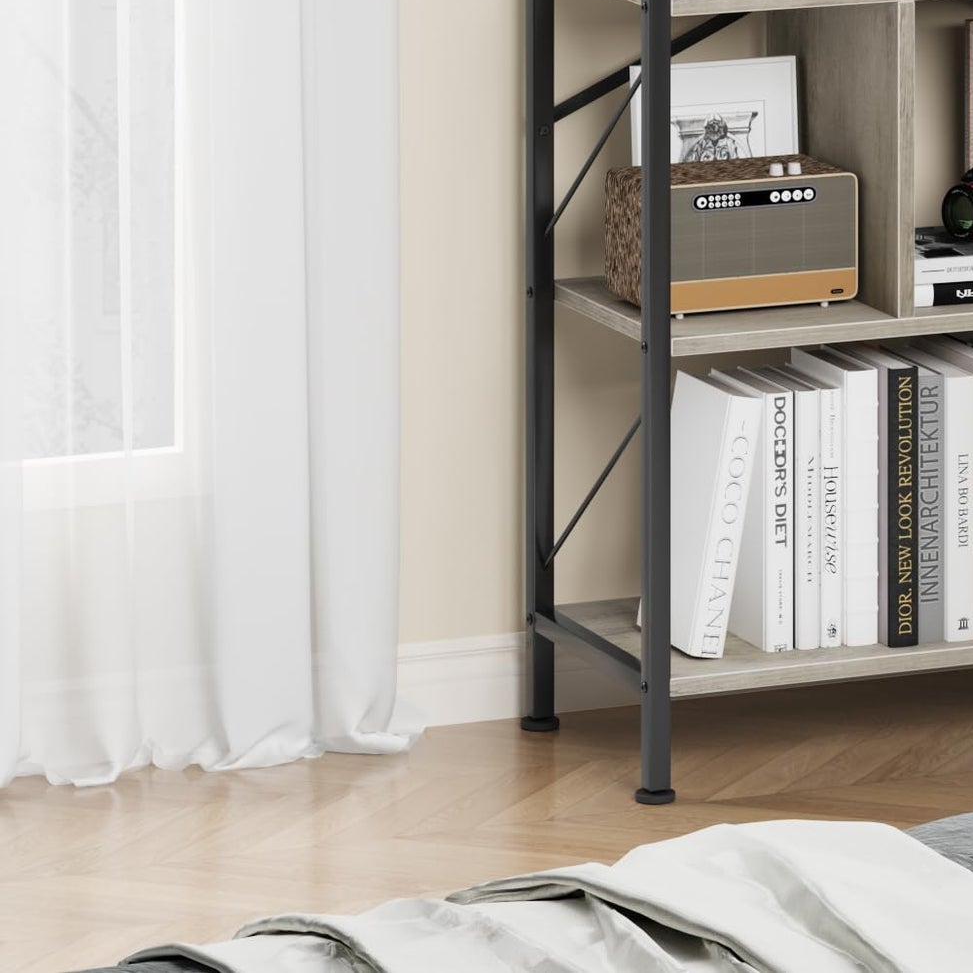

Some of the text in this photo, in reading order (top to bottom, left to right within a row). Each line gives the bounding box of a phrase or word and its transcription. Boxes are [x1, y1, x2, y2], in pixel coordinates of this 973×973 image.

[774, 504, 788, 547] DIET
[823, 466, 839, 575] Housewise
[898, 377, 912, 635] DIOR. NEW LOOK REVOLUTION
[920, 385, 939, 603] INNENARCHITEKTUR
[958, 454, 969, 548] LINA BO BARDI
